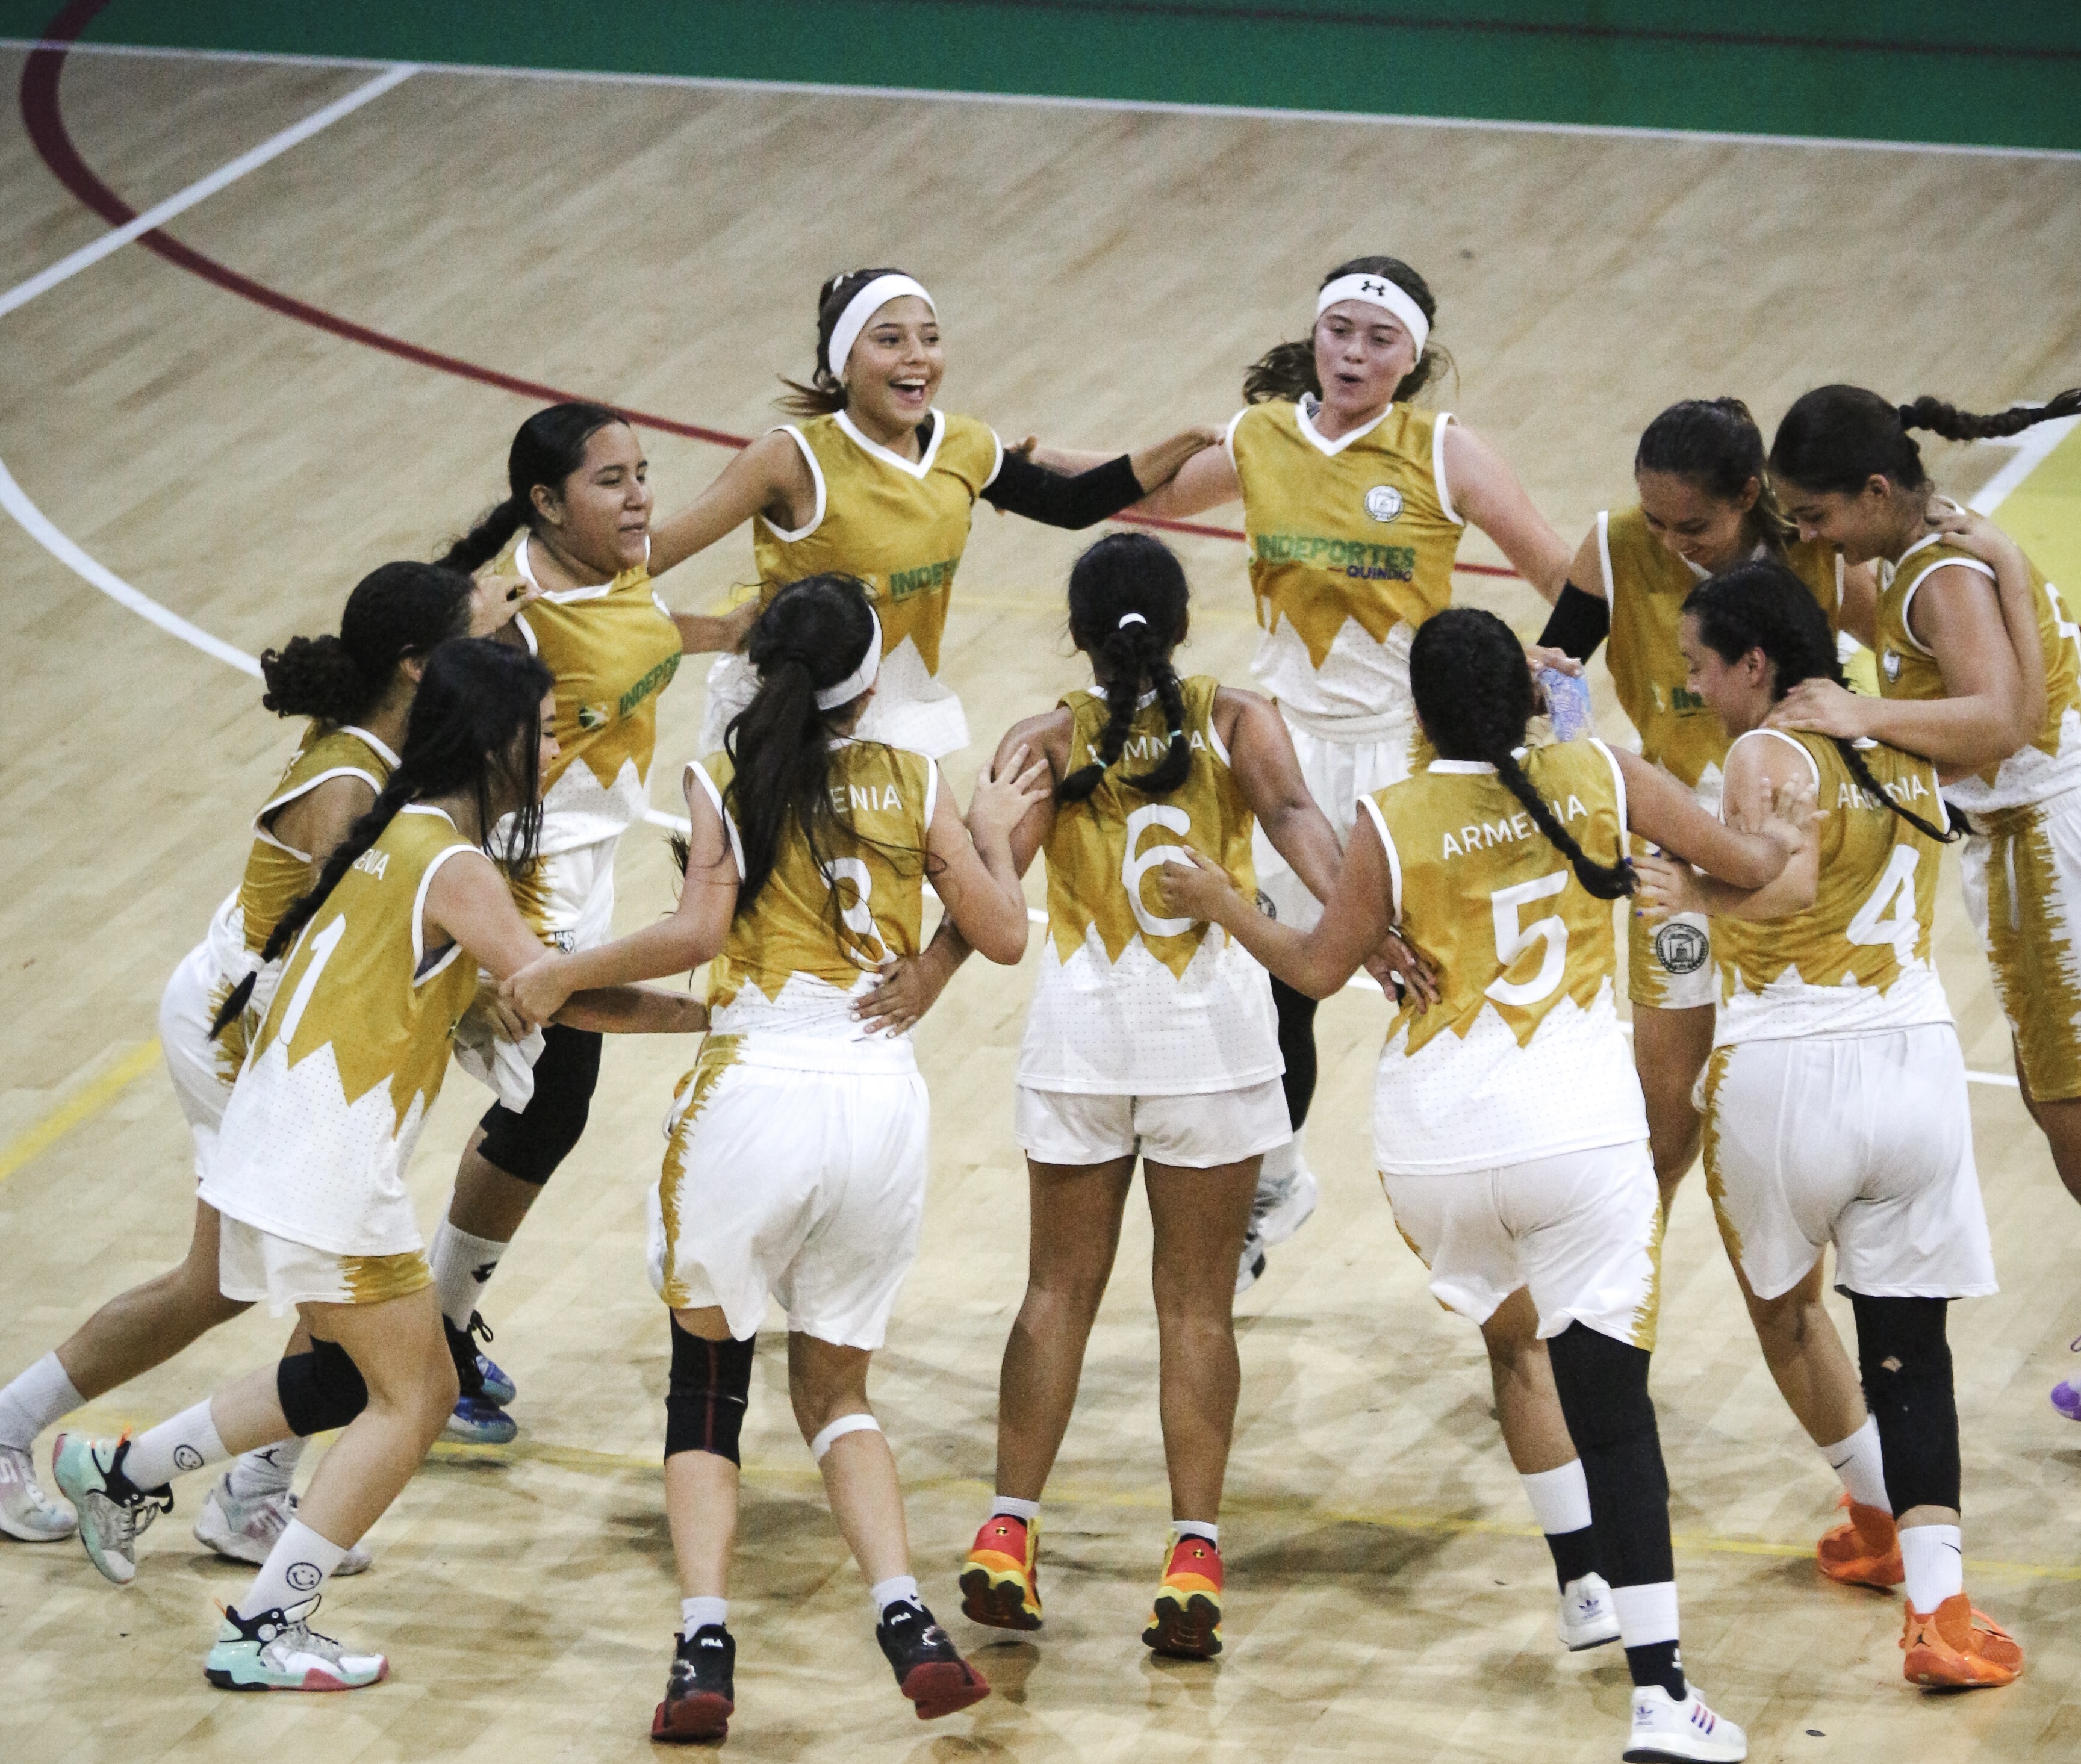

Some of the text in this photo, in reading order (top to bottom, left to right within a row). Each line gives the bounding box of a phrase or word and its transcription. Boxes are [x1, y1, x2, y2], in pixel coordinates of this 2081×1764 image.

[1122, 803, 1201, 937] 6
[1443, 794, 1588, 860] ARMEIA
[1484, 870, 1569, 1006] 5
[1846, 843, 1920, 963] 4
[279, 912, 346, 1045] 1
